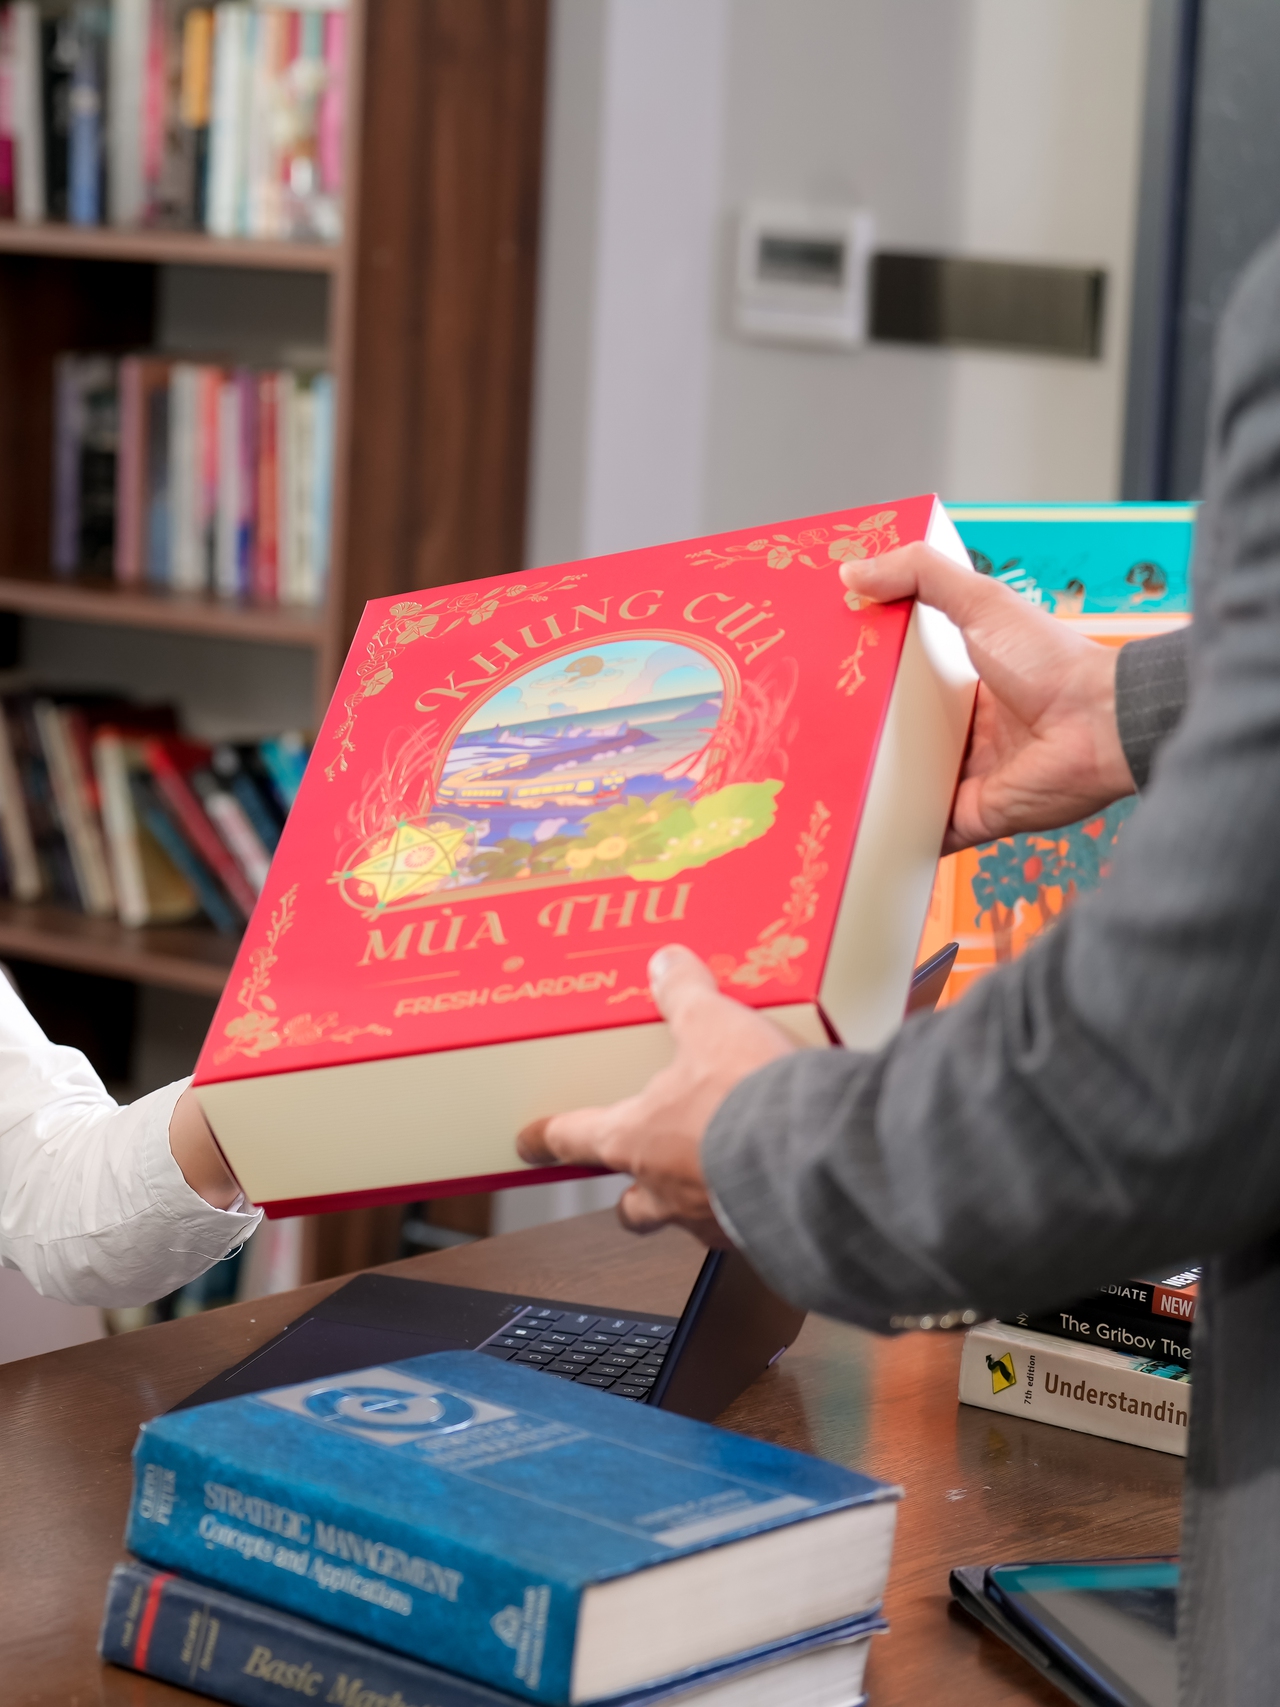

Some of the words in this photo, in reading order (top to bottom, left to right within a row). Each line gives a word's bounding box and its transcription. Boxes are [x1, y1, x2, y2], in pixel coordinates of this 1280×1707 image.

[414, 590, 664, 713] KHUNG
[683, 591, 786, 666] CỬA
[355, 907, 509, 967] MÙA
[537, 882, 695, 938] THU
[393, 986, 490, 1018] FRESH
[490, 968, 619, 1004] GARDEN
[1096, 1283, 1148, 1303] EDIATE
[1160, 1270, 1202, 1288] NEW
[1160, 1293, 1194, 1319] NEW
[1059, 1312, 1091, 1336] The
[1095, 1322, 1157, 1351] Gribov
[1025, 1354, 1037, 1388] edition
[1023, 1389, 1033, 1406] 7th
[1043, 1371, 1189, 1428] Understandin
[198, 1512, 275, 1562] Concepts
[272, 1545, 311, 1577] and
[306, 1555, 414, 1618] Applications
[202, 1479, 312, 1546] STRATEGIC
[313, 1519, 464, 1603] MANAGEMENT
[241, 1643, 324, 1697] Basic
